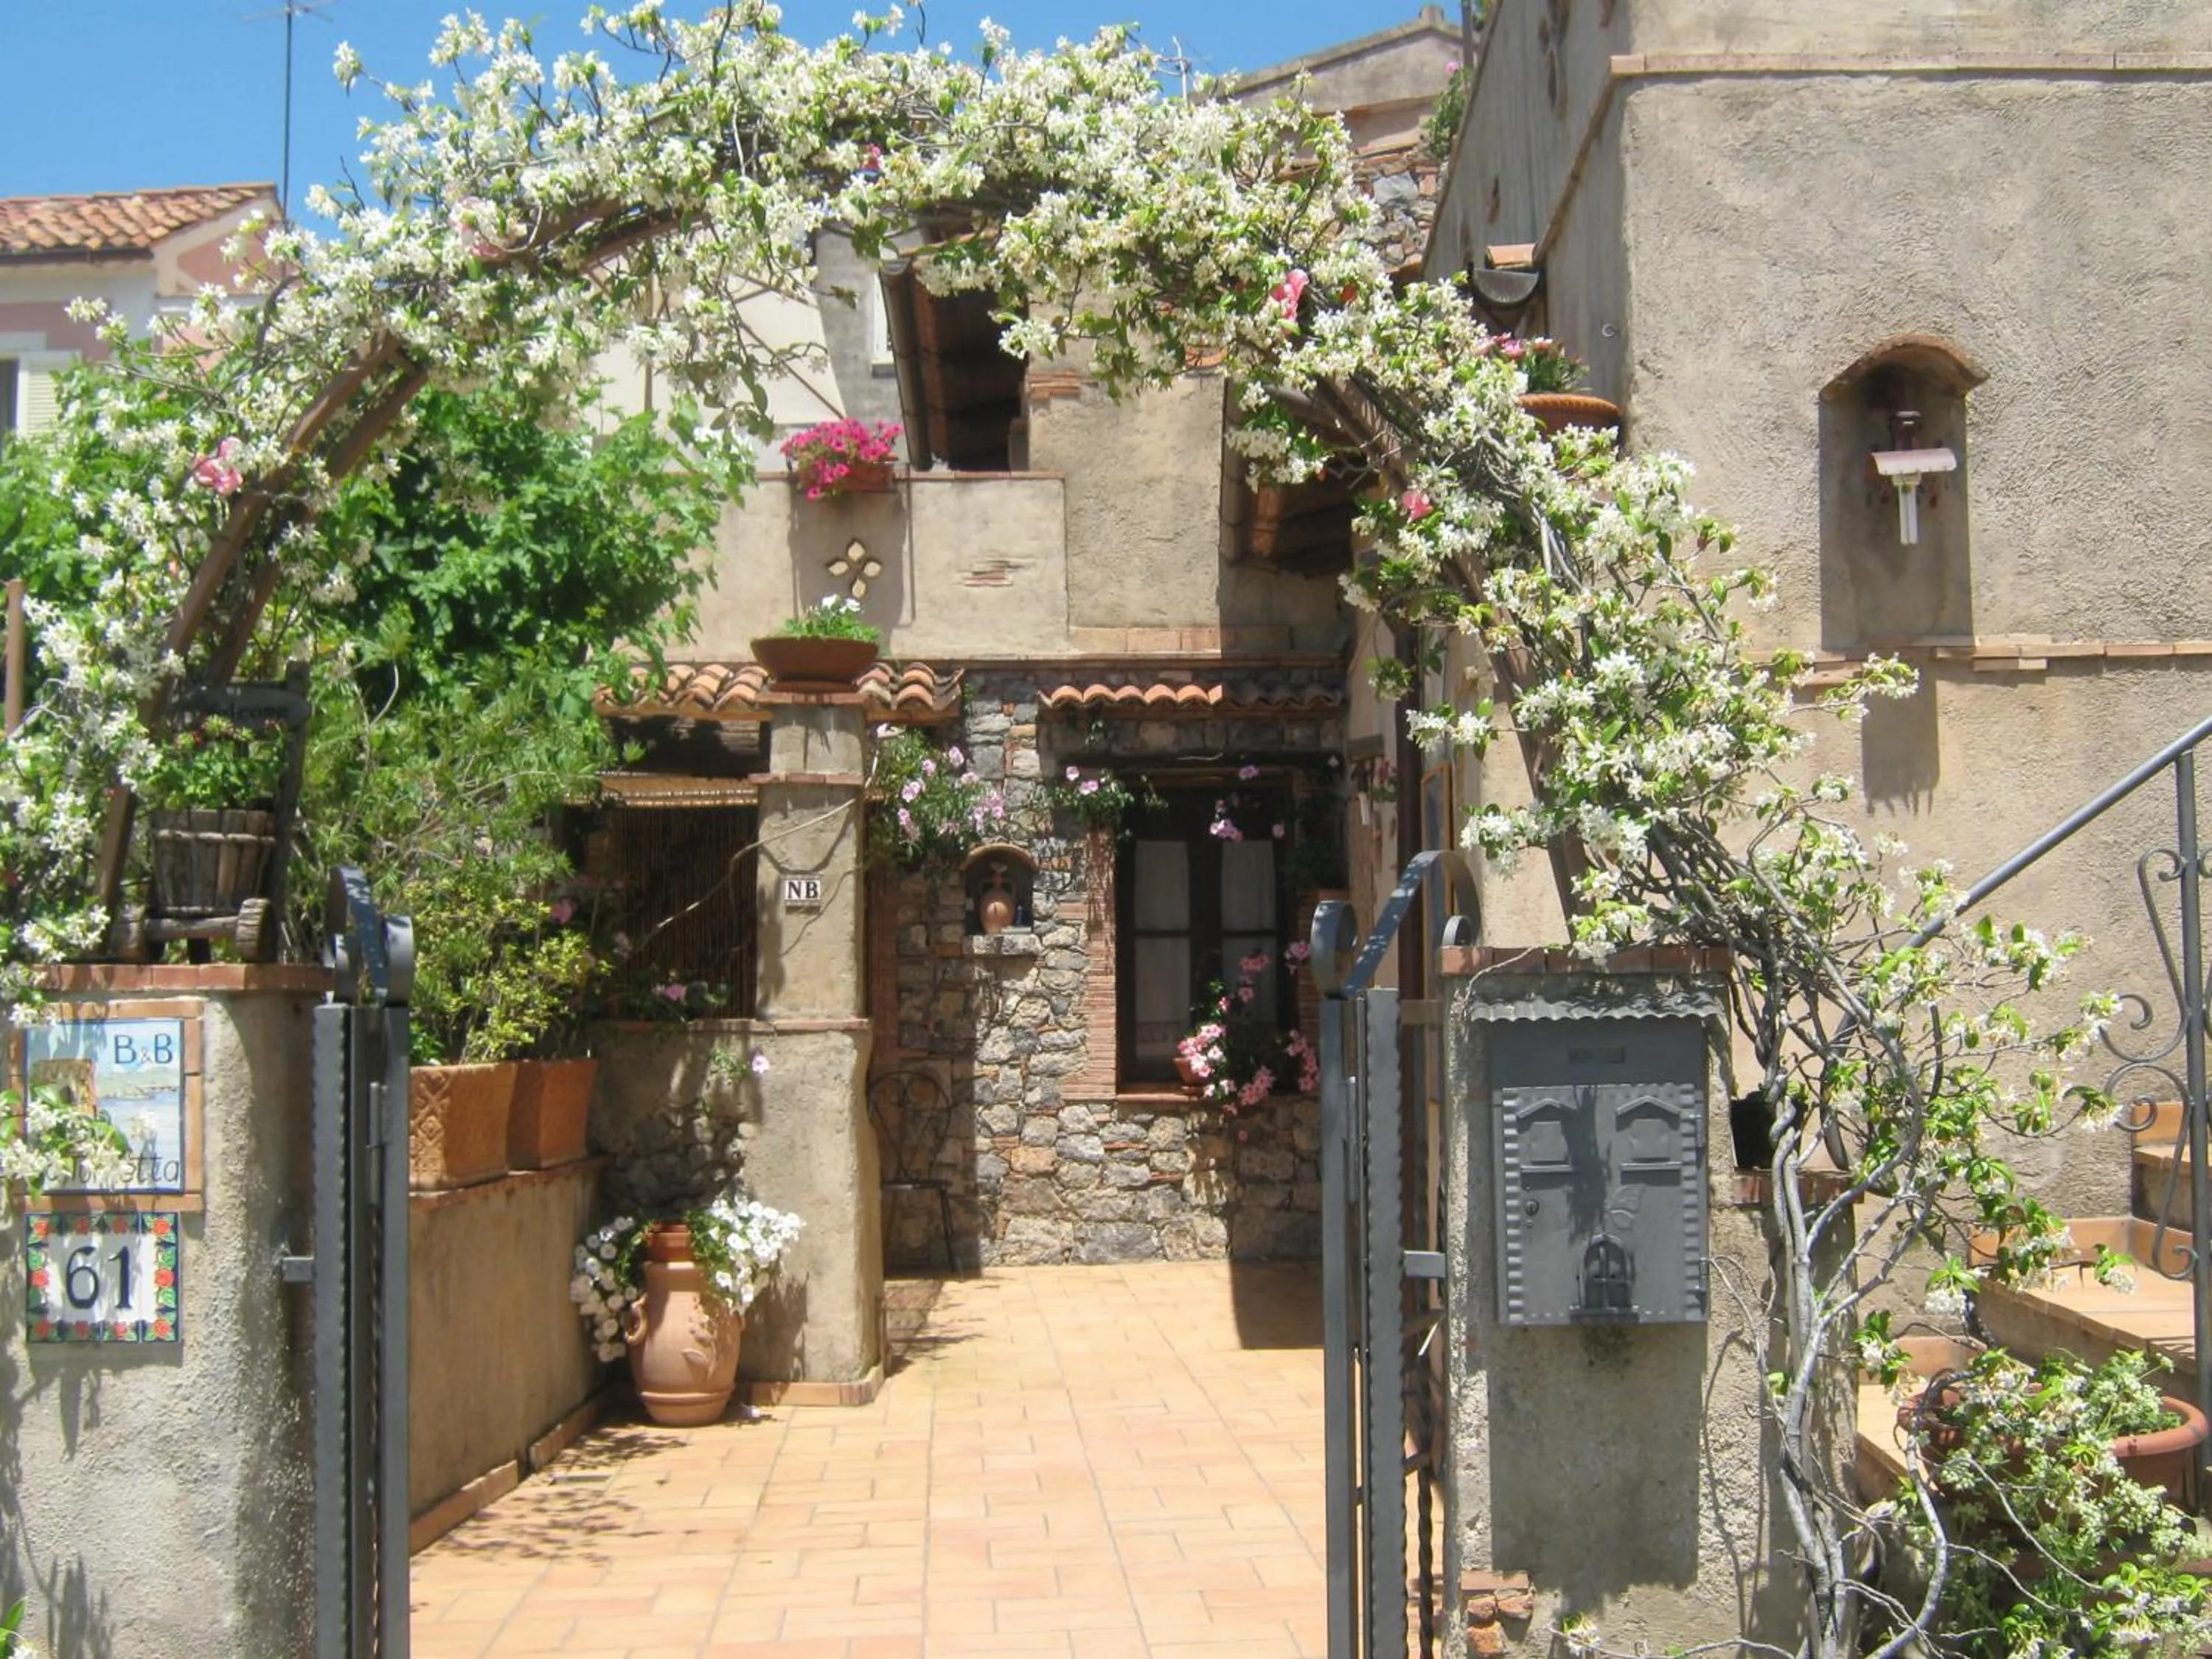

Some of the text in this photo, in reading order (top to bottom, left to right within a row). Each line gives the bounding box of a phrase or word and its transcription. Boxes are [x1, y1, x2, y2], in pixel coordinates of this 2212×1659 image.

[787, 880, 818, 899] NB
[114, 1034, 173, 1064] B&B
[66, 1245, 133, 1310] 61
